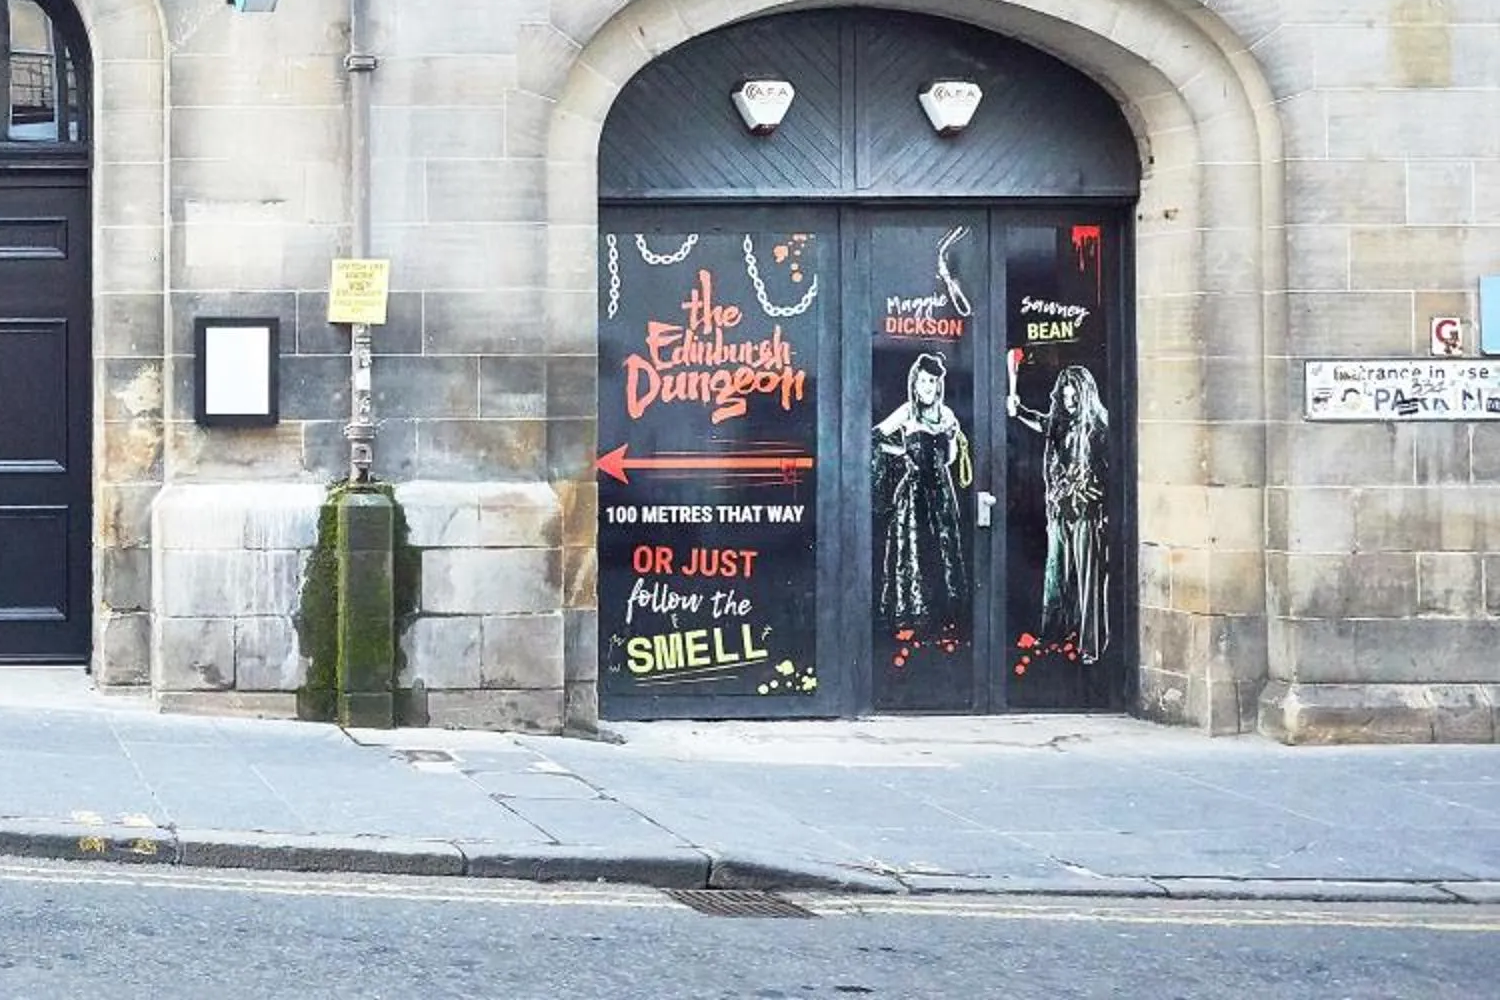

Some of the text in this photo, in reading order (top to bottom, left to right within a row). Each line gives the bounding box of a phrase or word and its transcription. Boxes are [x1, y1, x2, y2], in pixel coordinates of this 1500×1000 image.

[681, 269, 743, 335] the
[645, 321, 797, 371] Edinburgh
[885, 317, 964, 336] DICKSON
[1027, 321, 1074, 340] BEAN
[623, 353, 806, 425] Dungeon
[1429, 364, 1445, 379] in
[606, 505, 805, 524] 100 METRES THAT WAY
[633, 545, 758, 578] OR JUST
[626, 577, 753, 625] follow the
[627, 623, 769, 674] SMELL
